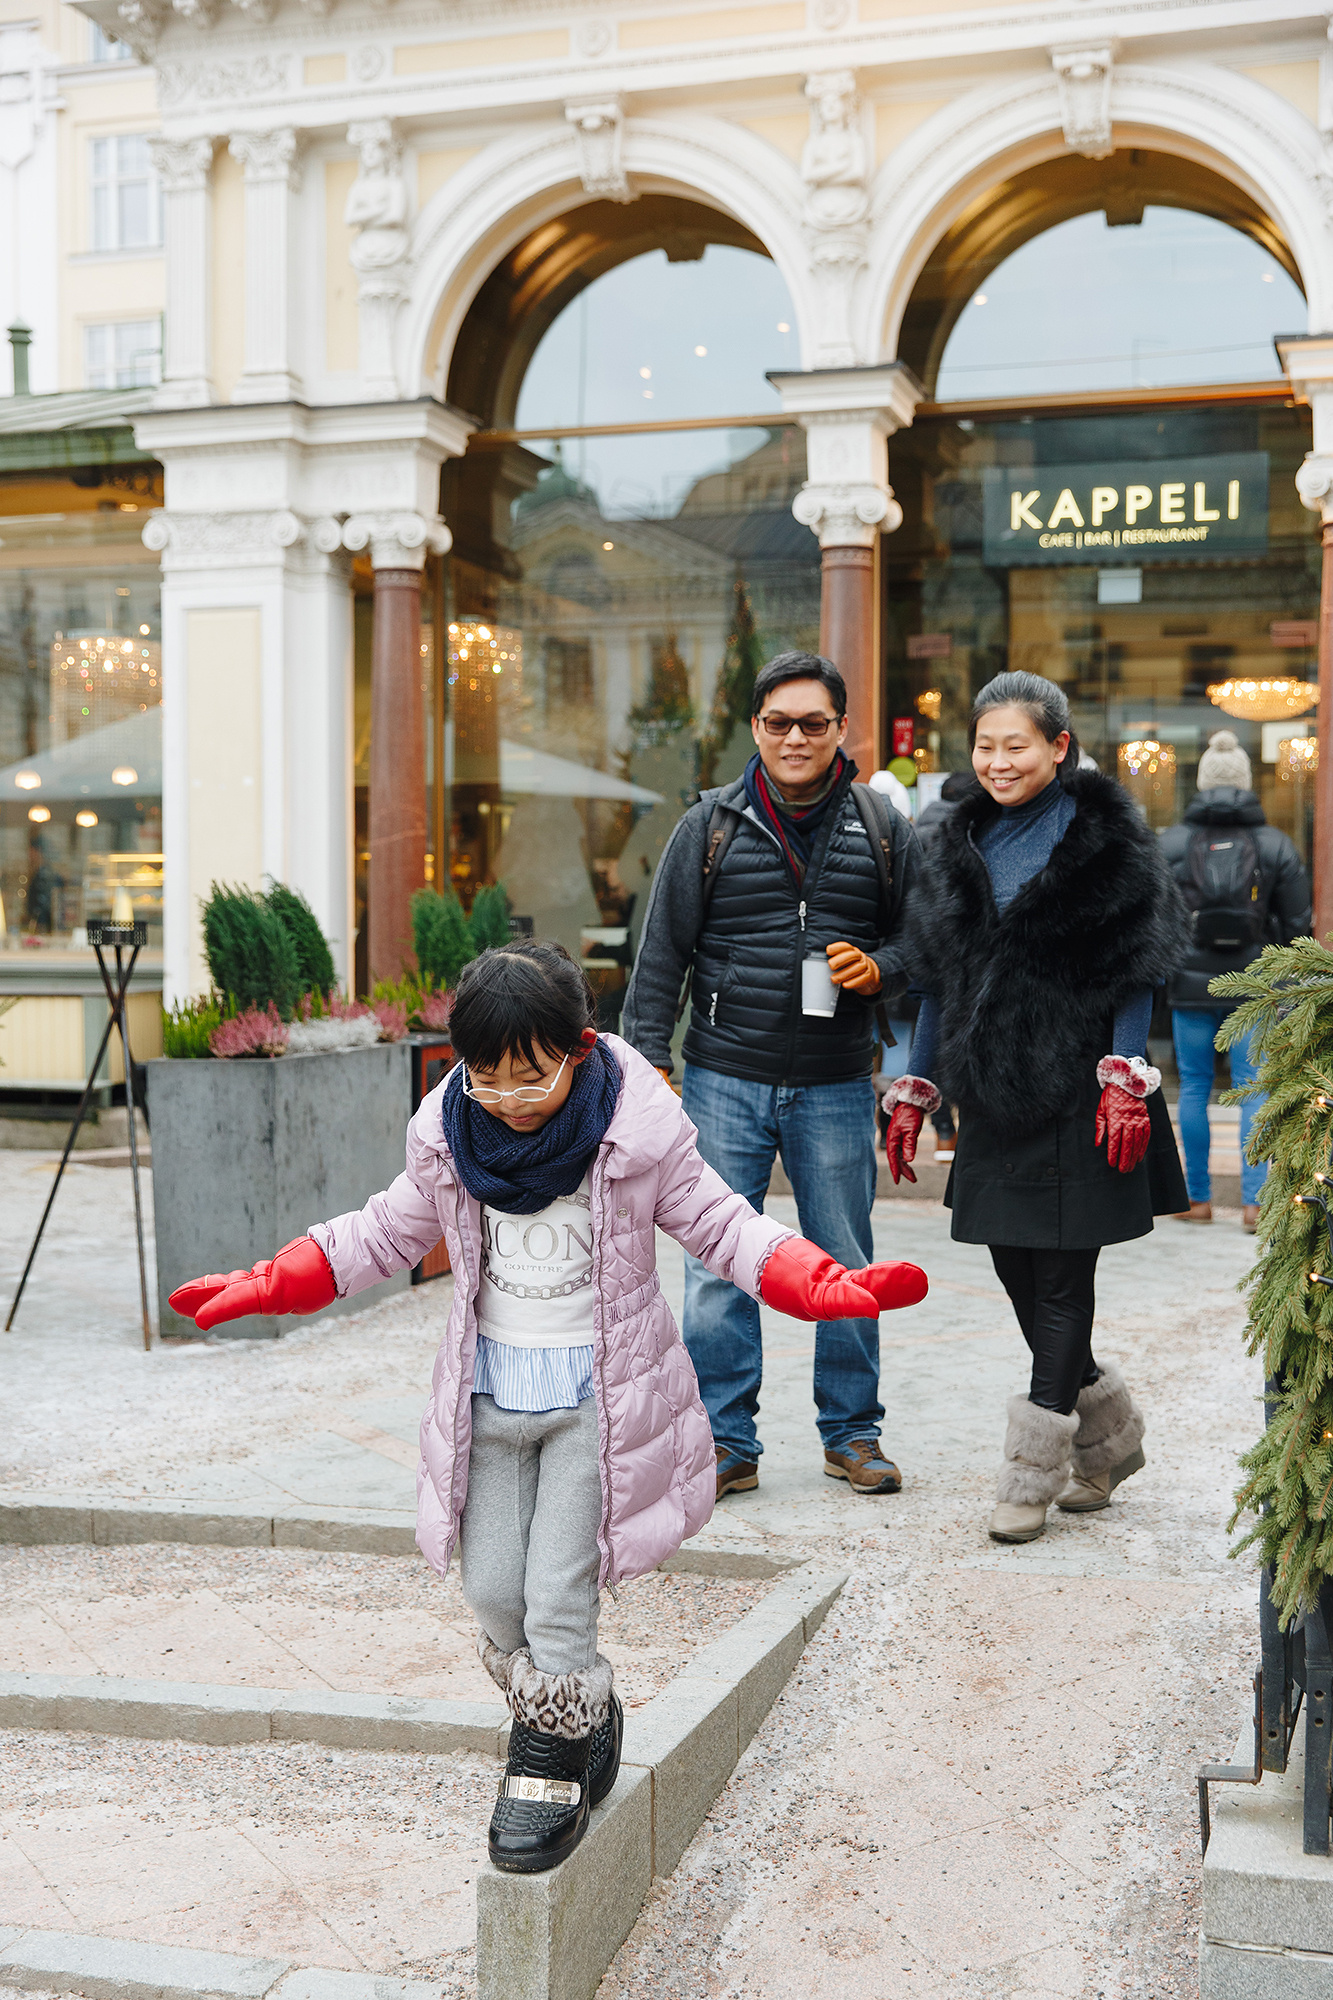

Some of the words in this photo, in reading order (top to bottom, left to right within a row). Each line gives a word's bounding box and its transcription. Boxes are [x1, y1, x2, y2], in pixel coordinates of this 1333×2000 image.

[1010, 480, 1240, 531] KAPPELI
[1039, 533, 1075, 549] CAFE
[1084, 531, 1113, 547] BAR
[1122, 526, 1210, 545] RESTAURANT
[483, 1214, 595, 1261] ICON
[504, 1262, 564, 1273] COUTURE
